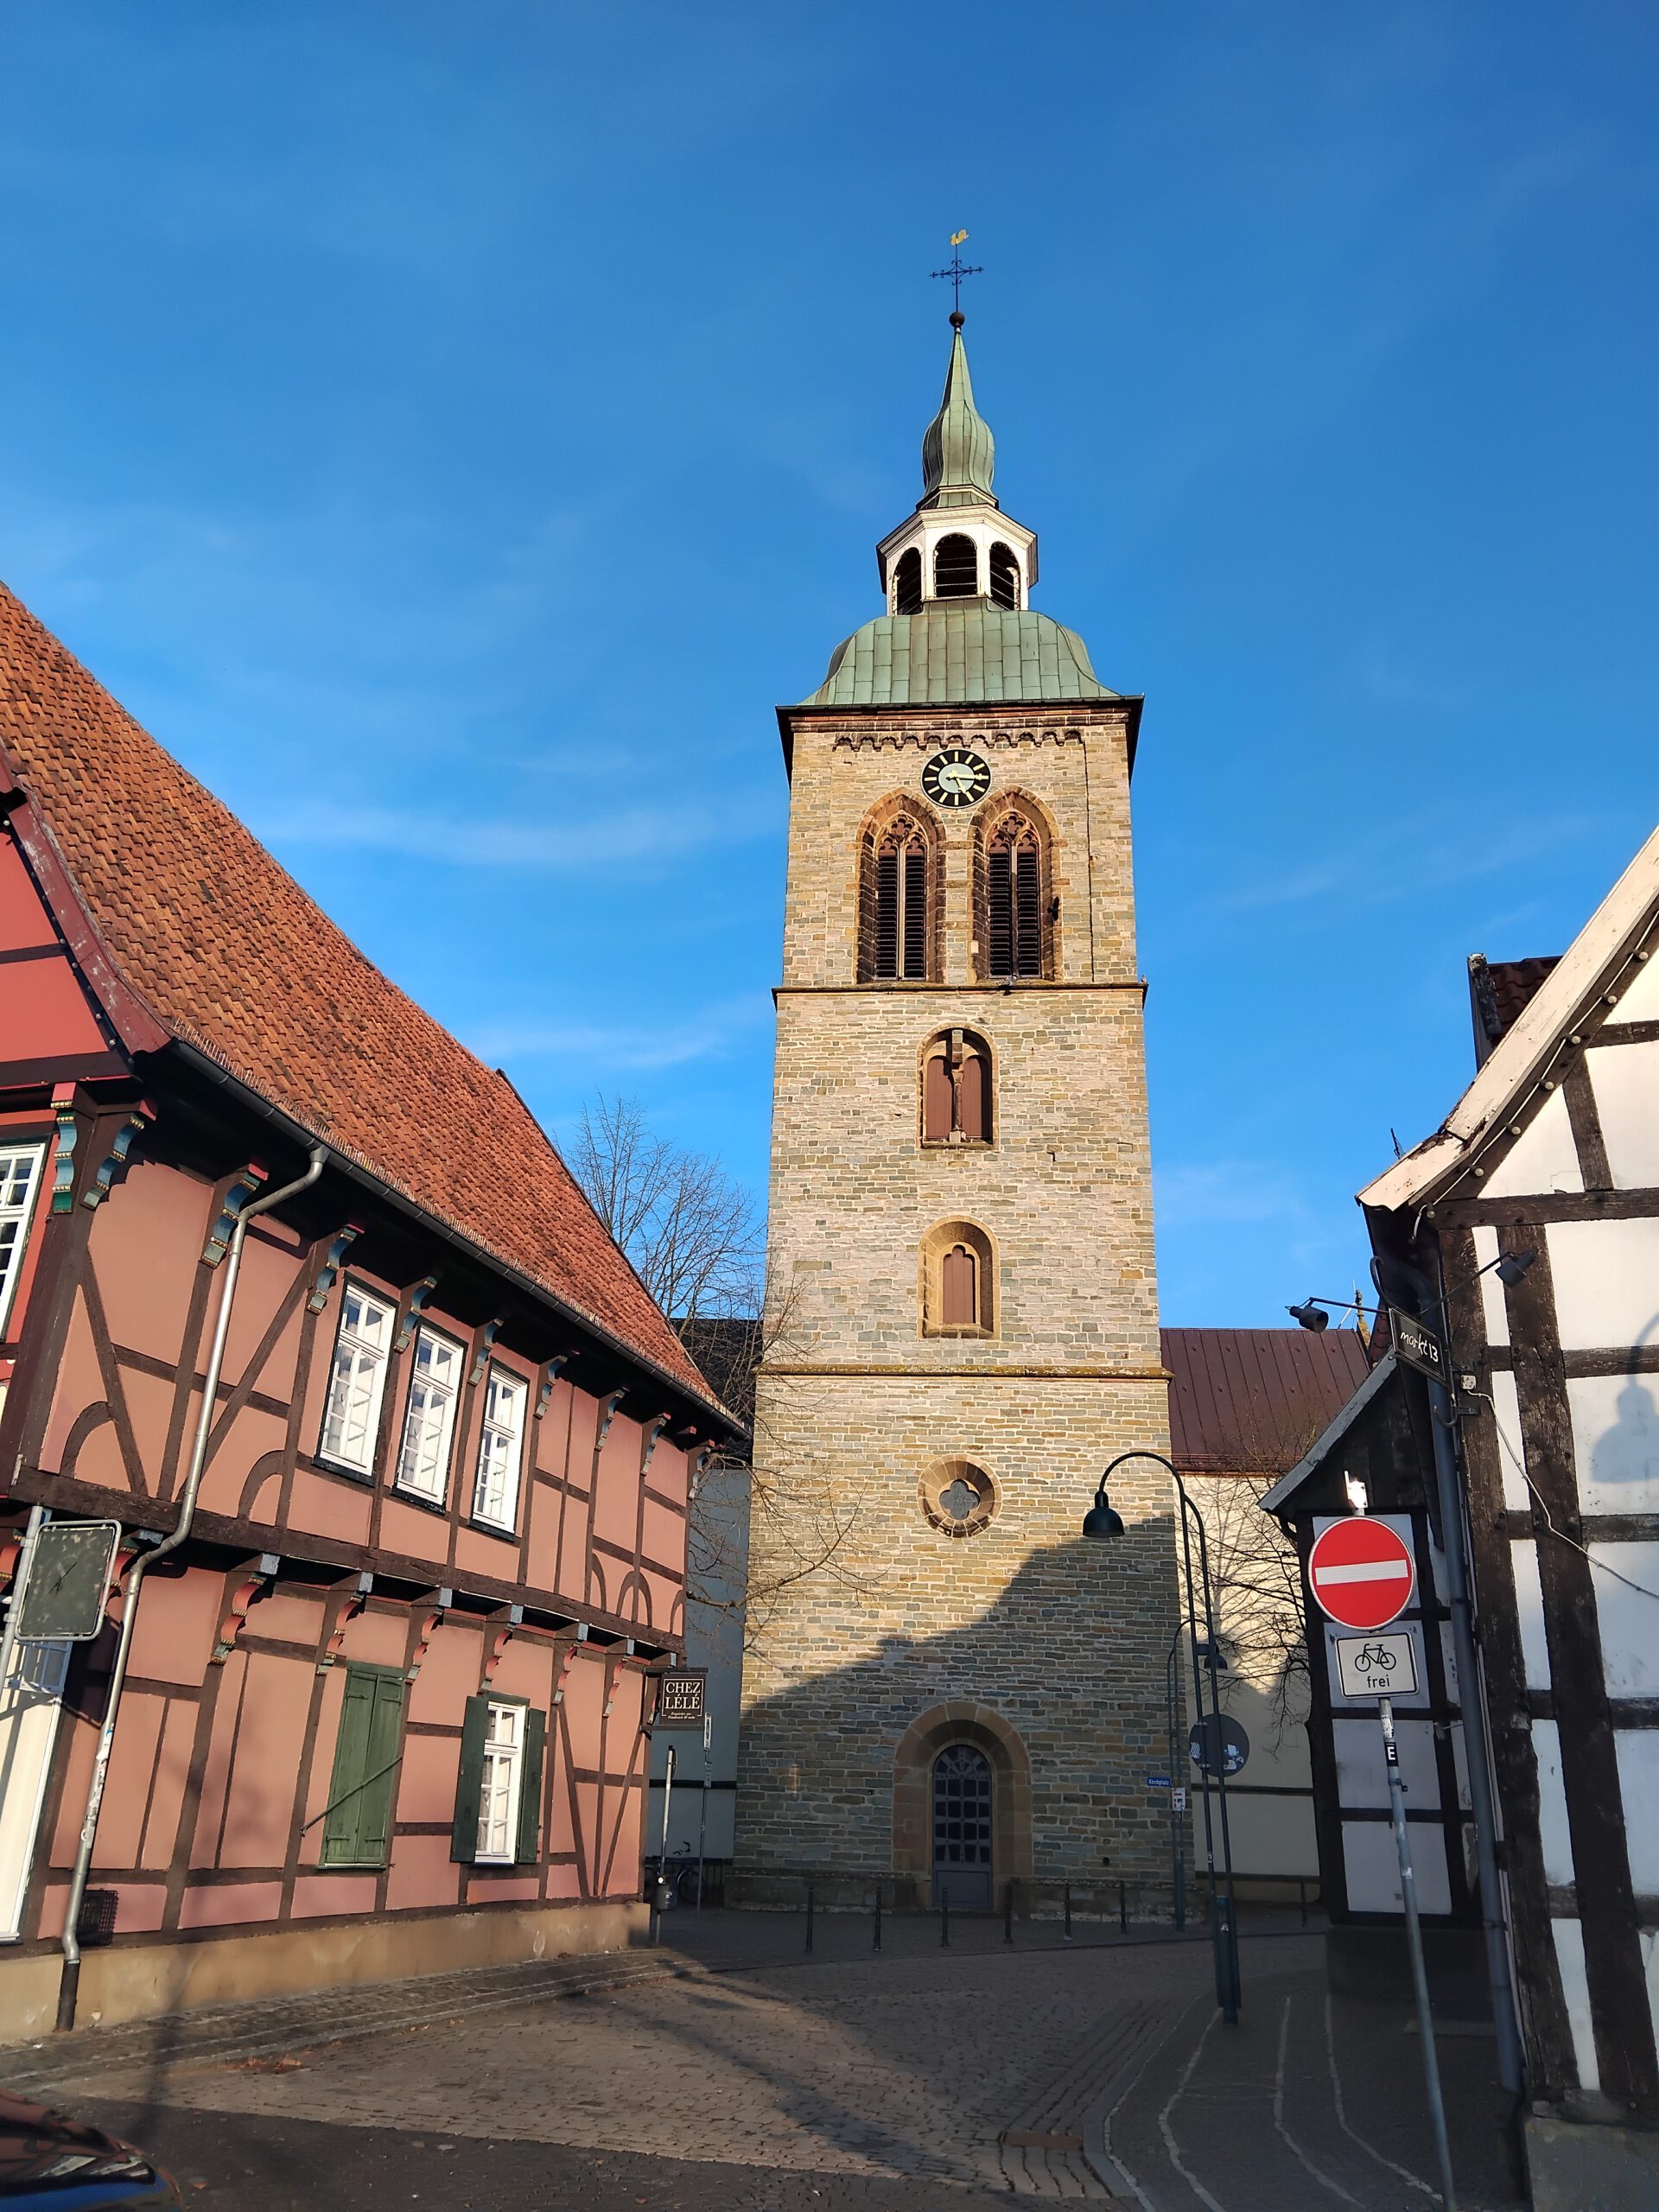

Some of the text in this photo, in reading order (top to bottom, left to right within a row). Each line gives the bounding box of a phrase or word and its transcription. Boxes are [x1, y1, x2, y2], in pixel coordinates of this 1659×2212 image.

[665, 1681, 701, 1694] CHEZ
[1367, 1674, 1390, 1688] frei
[664, 1694, 700, 1709] LÉLÉ
